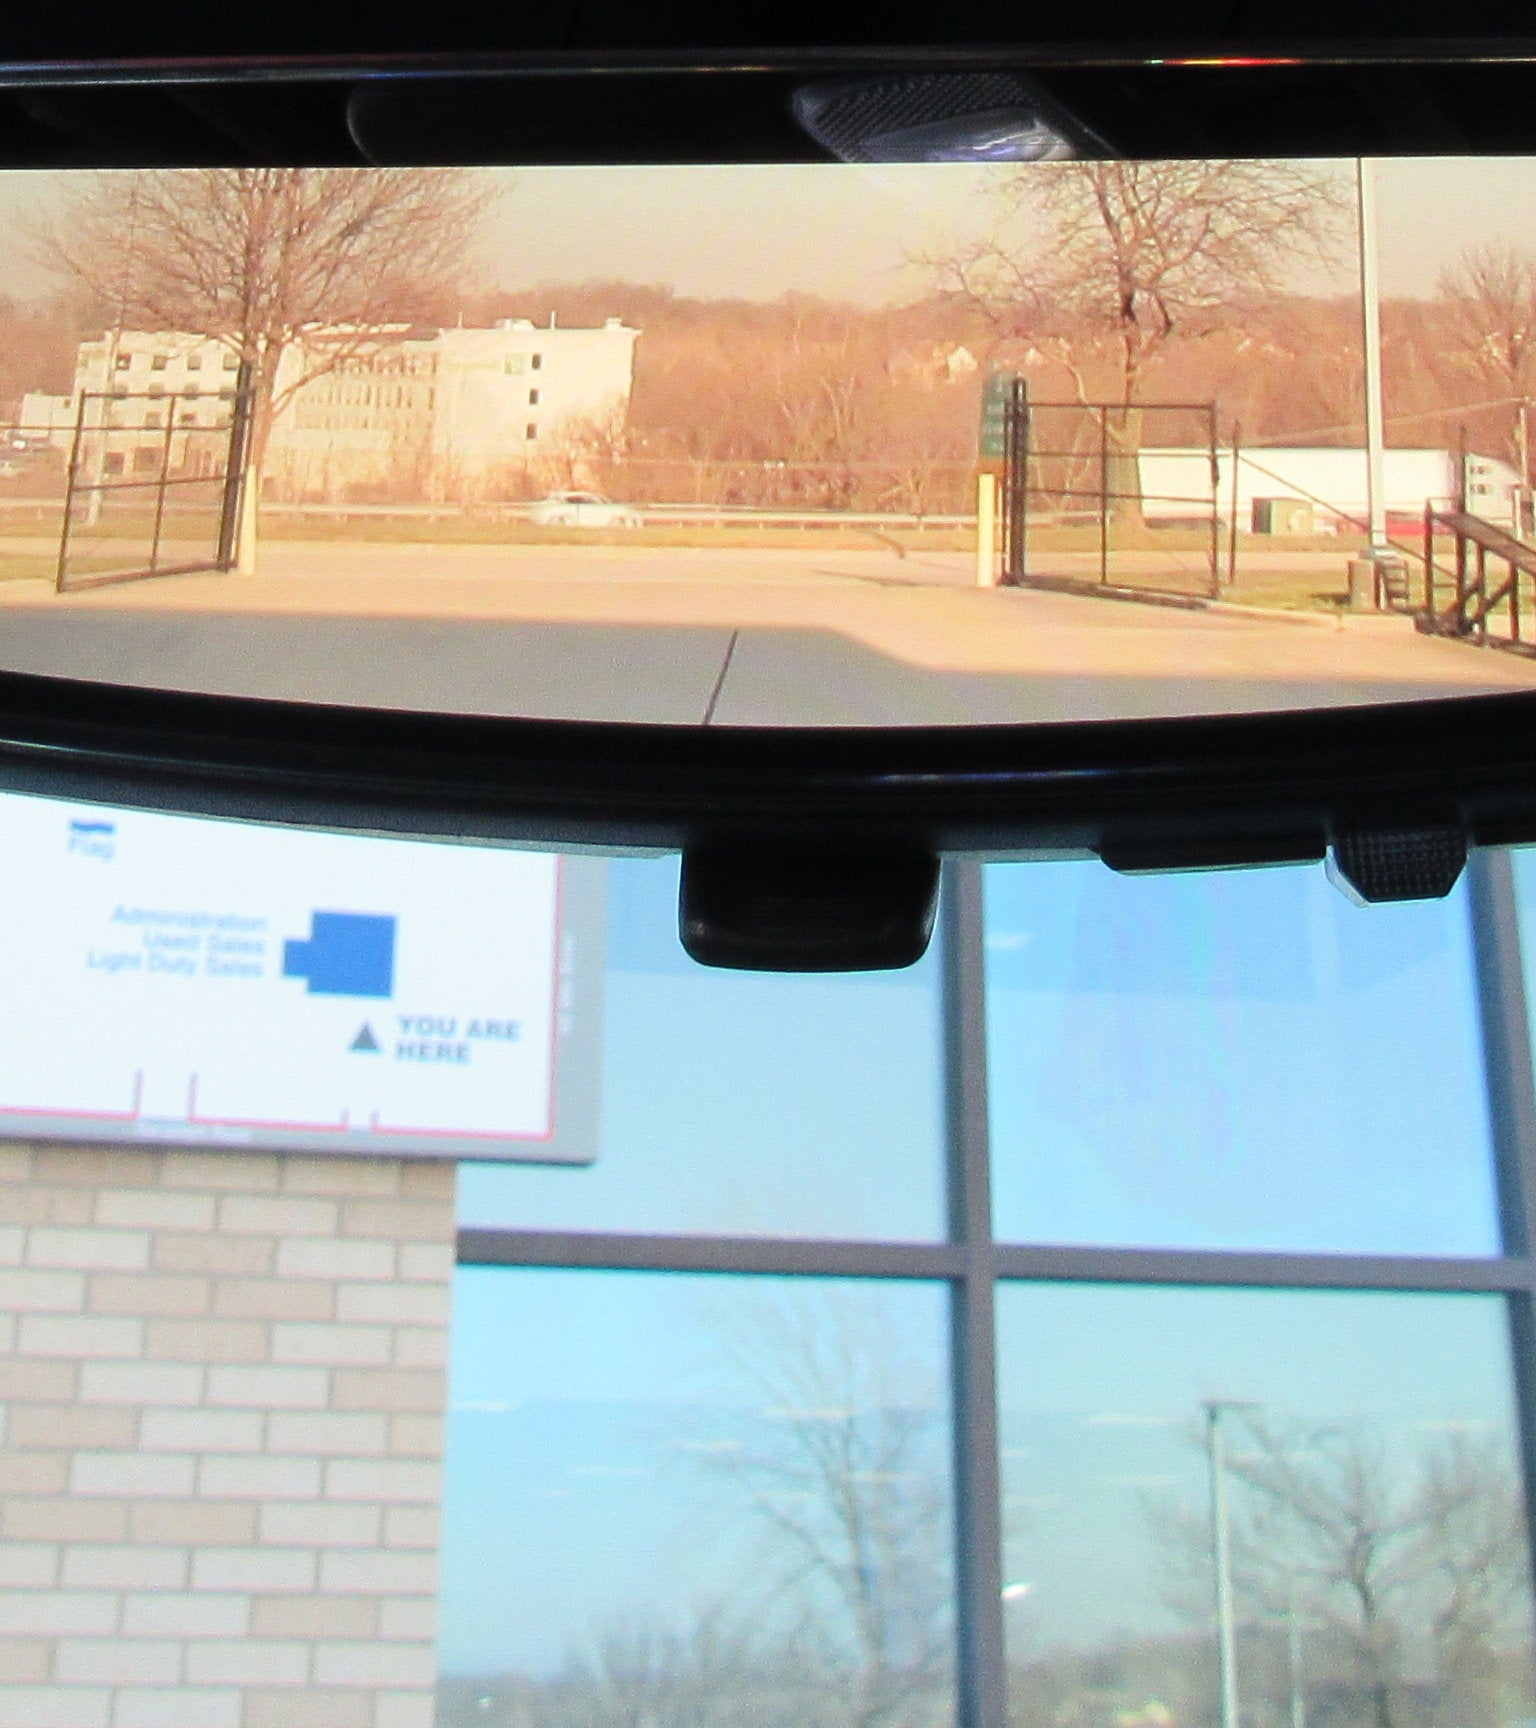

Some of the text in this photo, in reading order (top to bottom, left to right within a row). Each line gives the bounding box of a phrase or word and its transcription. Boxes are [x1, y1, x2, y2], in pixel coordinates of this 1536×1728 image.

[68, 836, 116, 861] Flag
[111, 905, 268, 932] Administration
[142, 930, 265, 955] Used Sales
[86, 949, 264, 978] Light Duty Sales
[397, 1012, 521, 1041] YOU ARE
[395, 1038, 472, 1065] HERE
